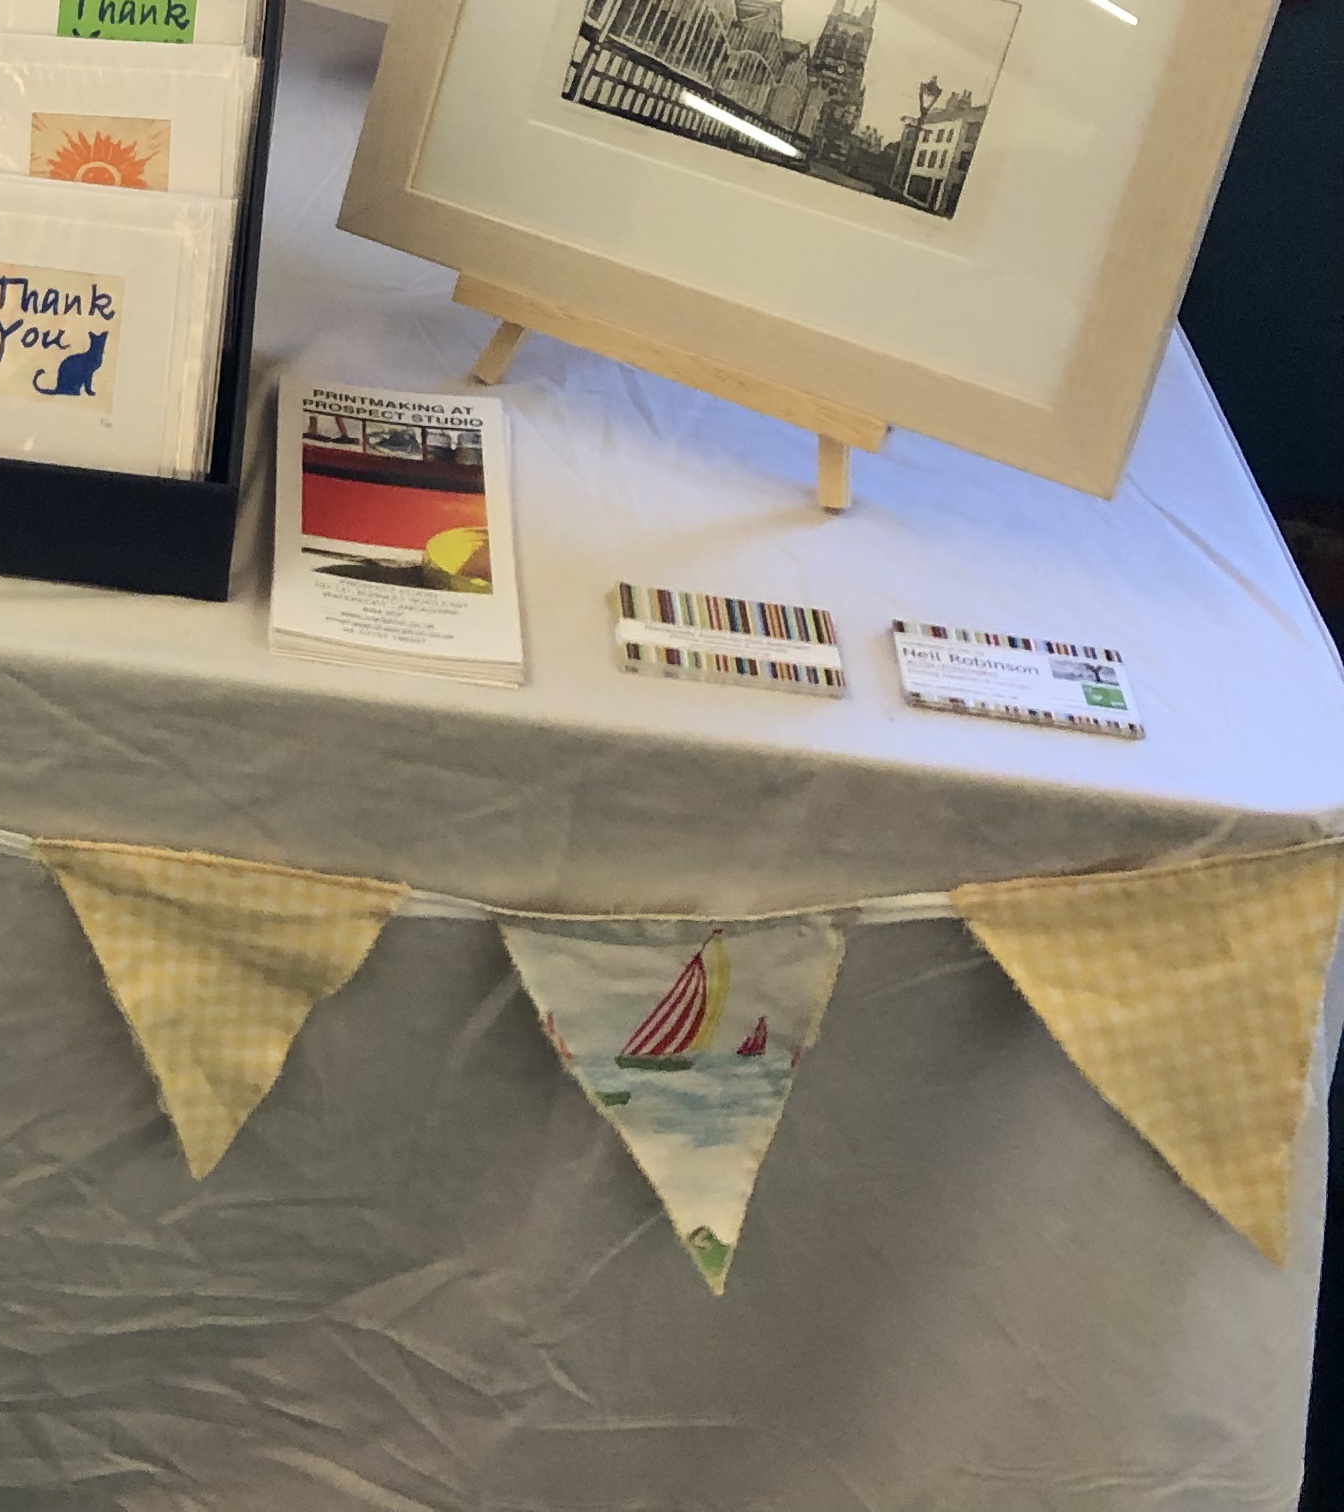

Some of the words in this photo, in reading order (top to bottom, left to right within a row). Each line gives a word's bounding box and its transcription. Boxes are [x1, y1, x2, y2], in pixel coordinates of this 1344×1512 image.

[302, 399, 405, 420] PROSPECT
[412, 413, 483, 427] STUDIO
[313, 388, 445, 415] PRINTMAKING
[451, 405, 474, 416] AT
[902, 647, 941, 661] Neil
[949, 653, 1039, 675] Robinson
